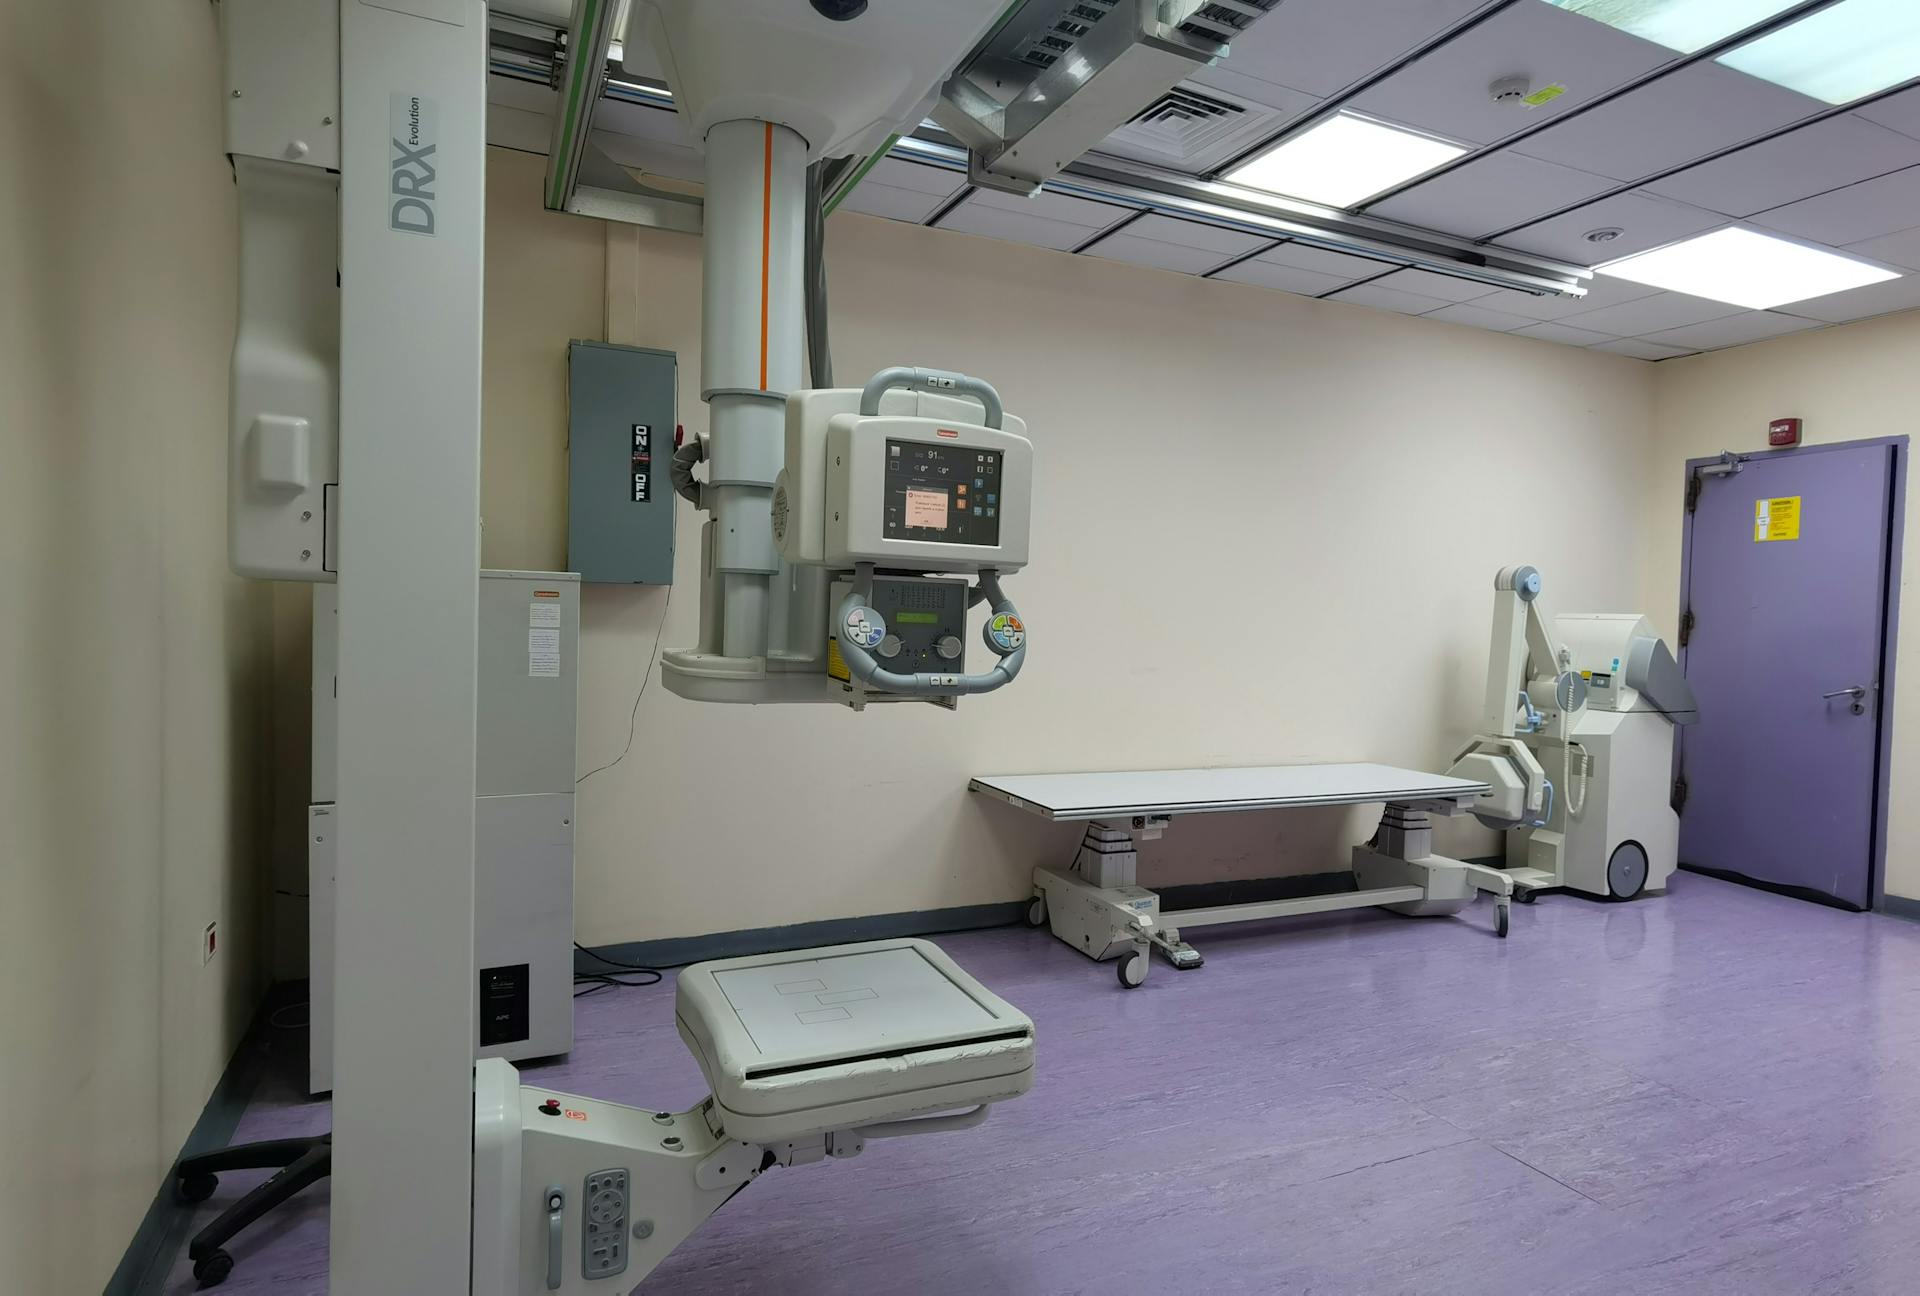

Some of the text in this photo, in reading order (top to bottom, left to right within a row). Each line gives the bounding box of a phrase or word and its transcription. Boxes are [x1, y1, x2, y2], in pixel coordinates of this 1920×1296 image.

[391, 97, 436, 234] DRX Evolution
[635, 425, 647, 446] ON
[927, 450, 938, 460] 91
[635, 473, 647, 501] OFF
